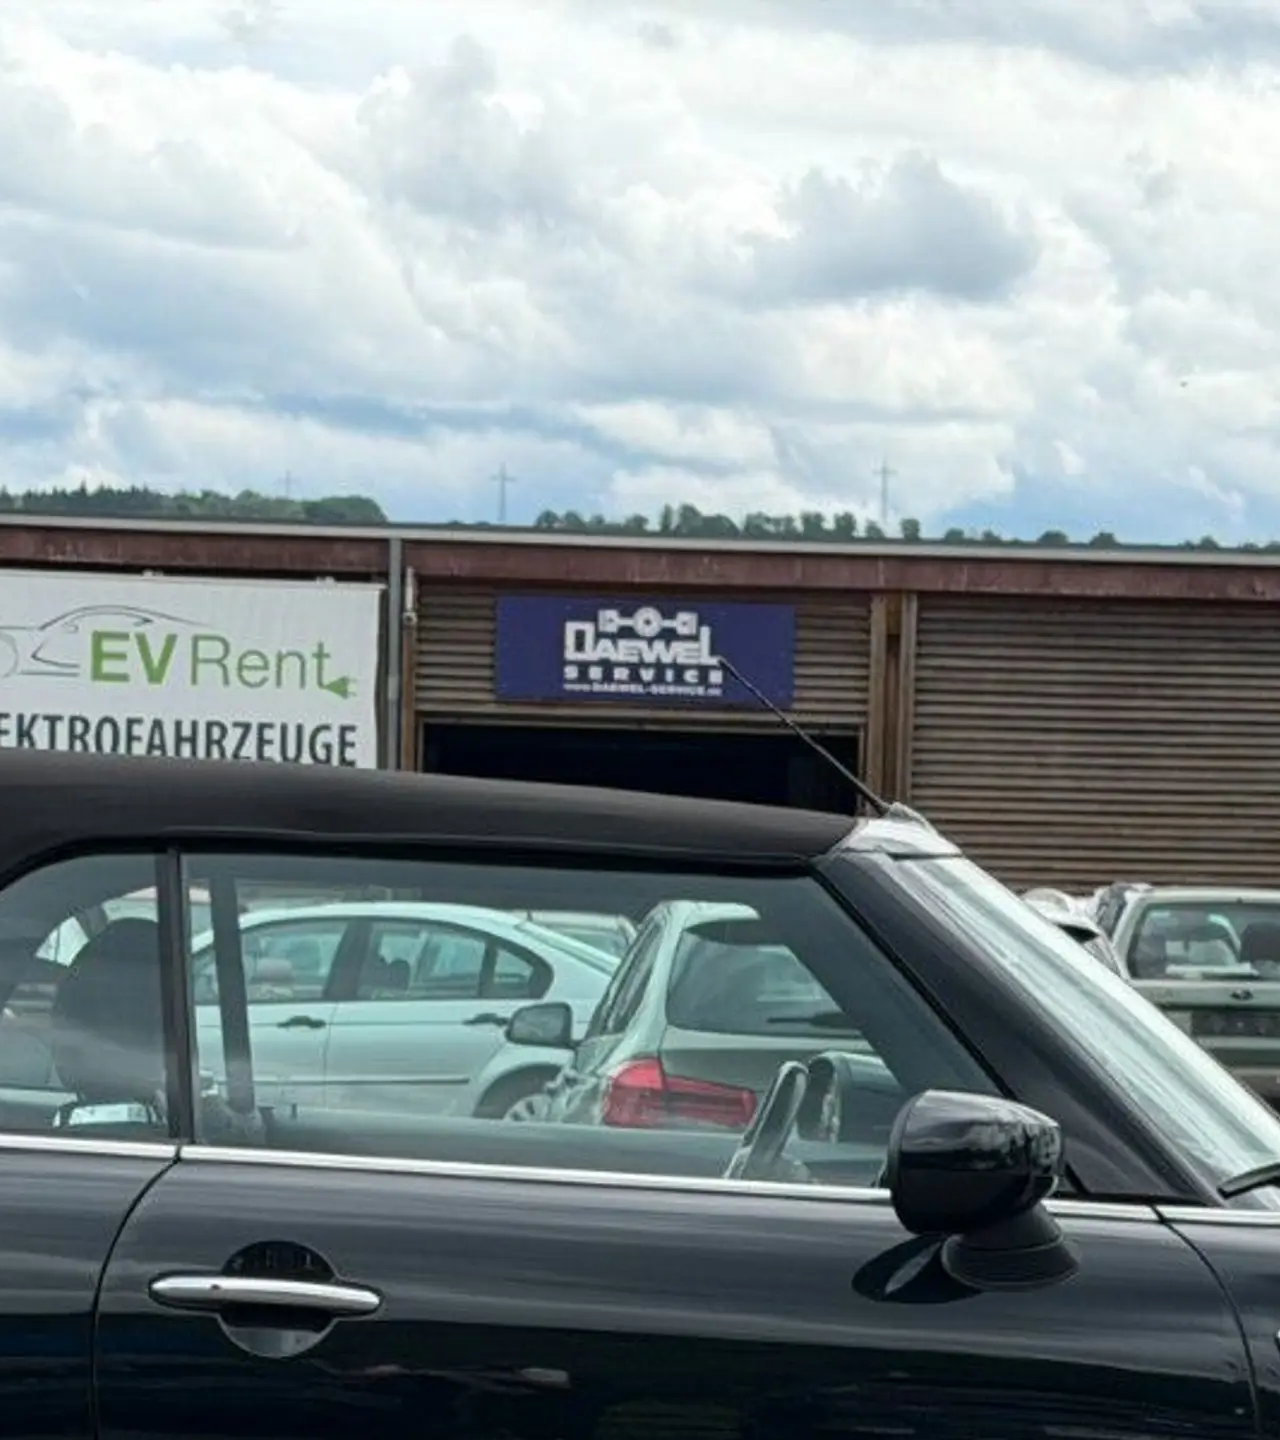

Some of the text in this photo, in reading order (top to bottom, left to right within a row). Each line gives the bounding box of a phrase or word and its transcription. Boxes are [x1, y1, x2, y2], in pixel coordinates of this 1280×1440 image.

[90, 630, 332, 690] EV Rent
[564, 665, 723, 684] SERVICE
